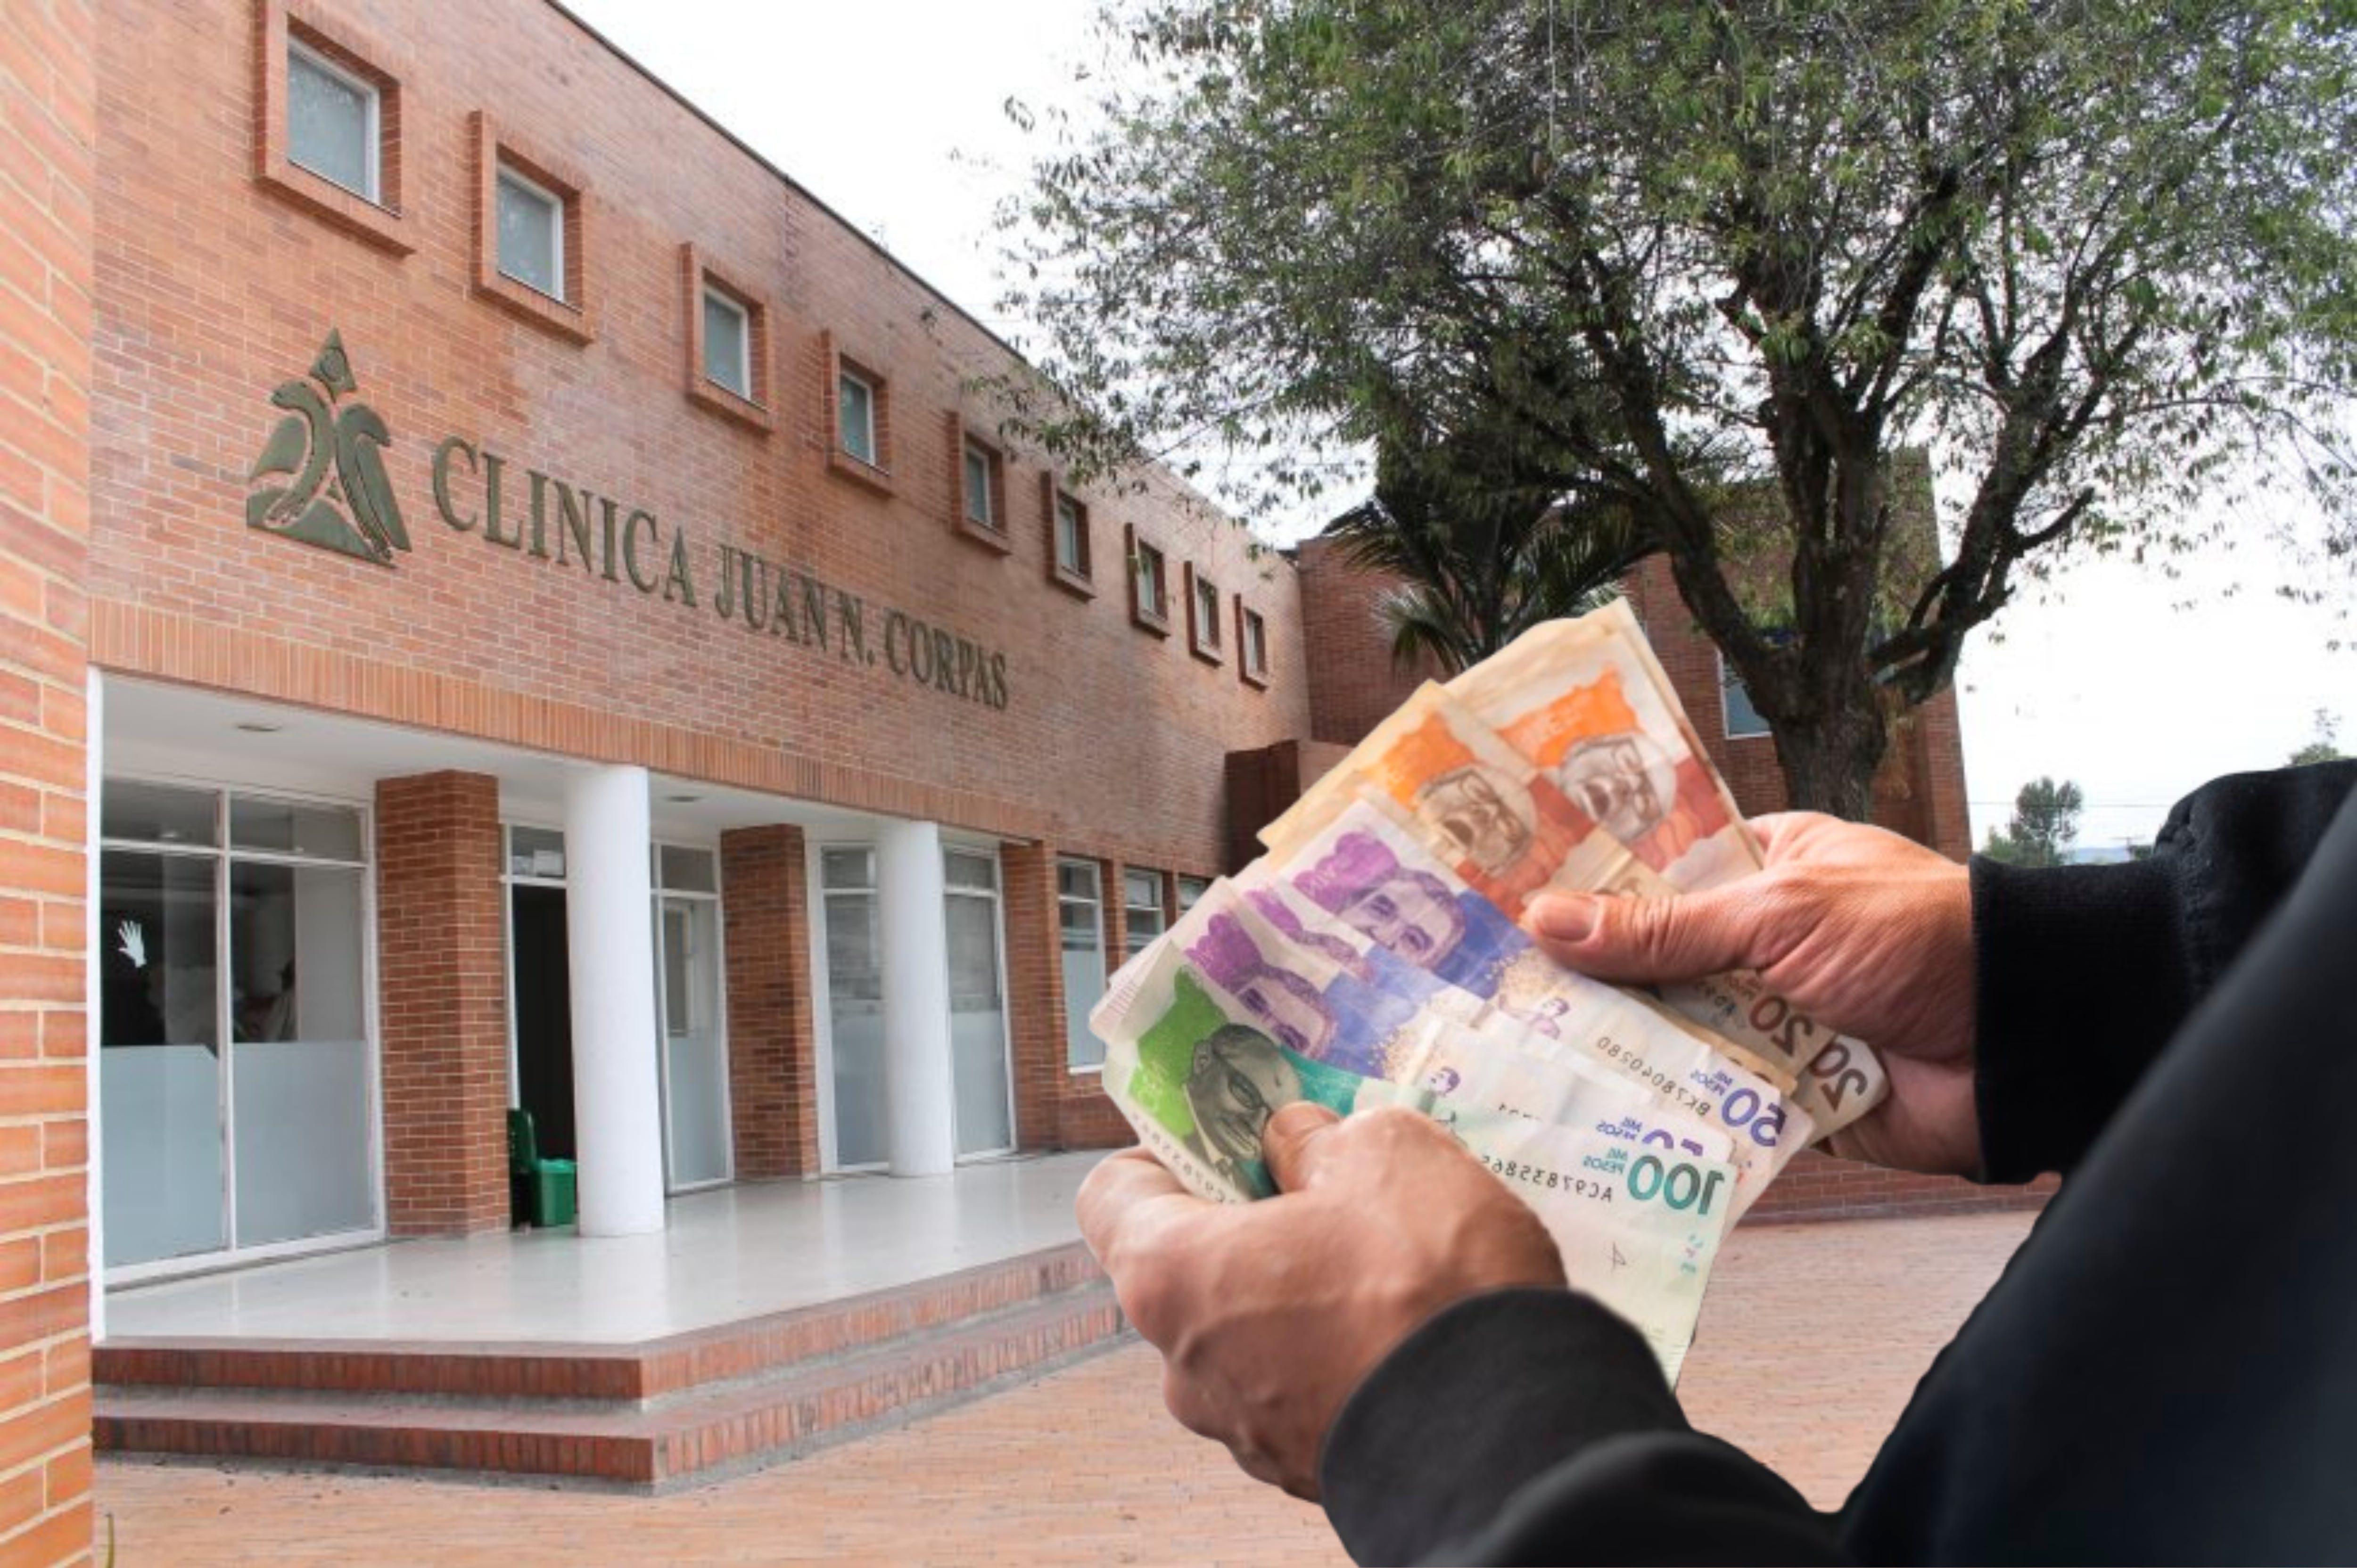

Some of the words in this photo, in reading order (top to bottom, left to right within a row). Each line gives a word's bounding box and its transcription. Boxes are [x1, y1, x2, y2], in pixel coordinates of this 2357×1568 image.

[432, 435, 697, 607] CLINICA
[715, 544, 827, 652] JUAN
[835, 589, 875, 667] N.
[884, 607, 1008, 710] CORPAS
